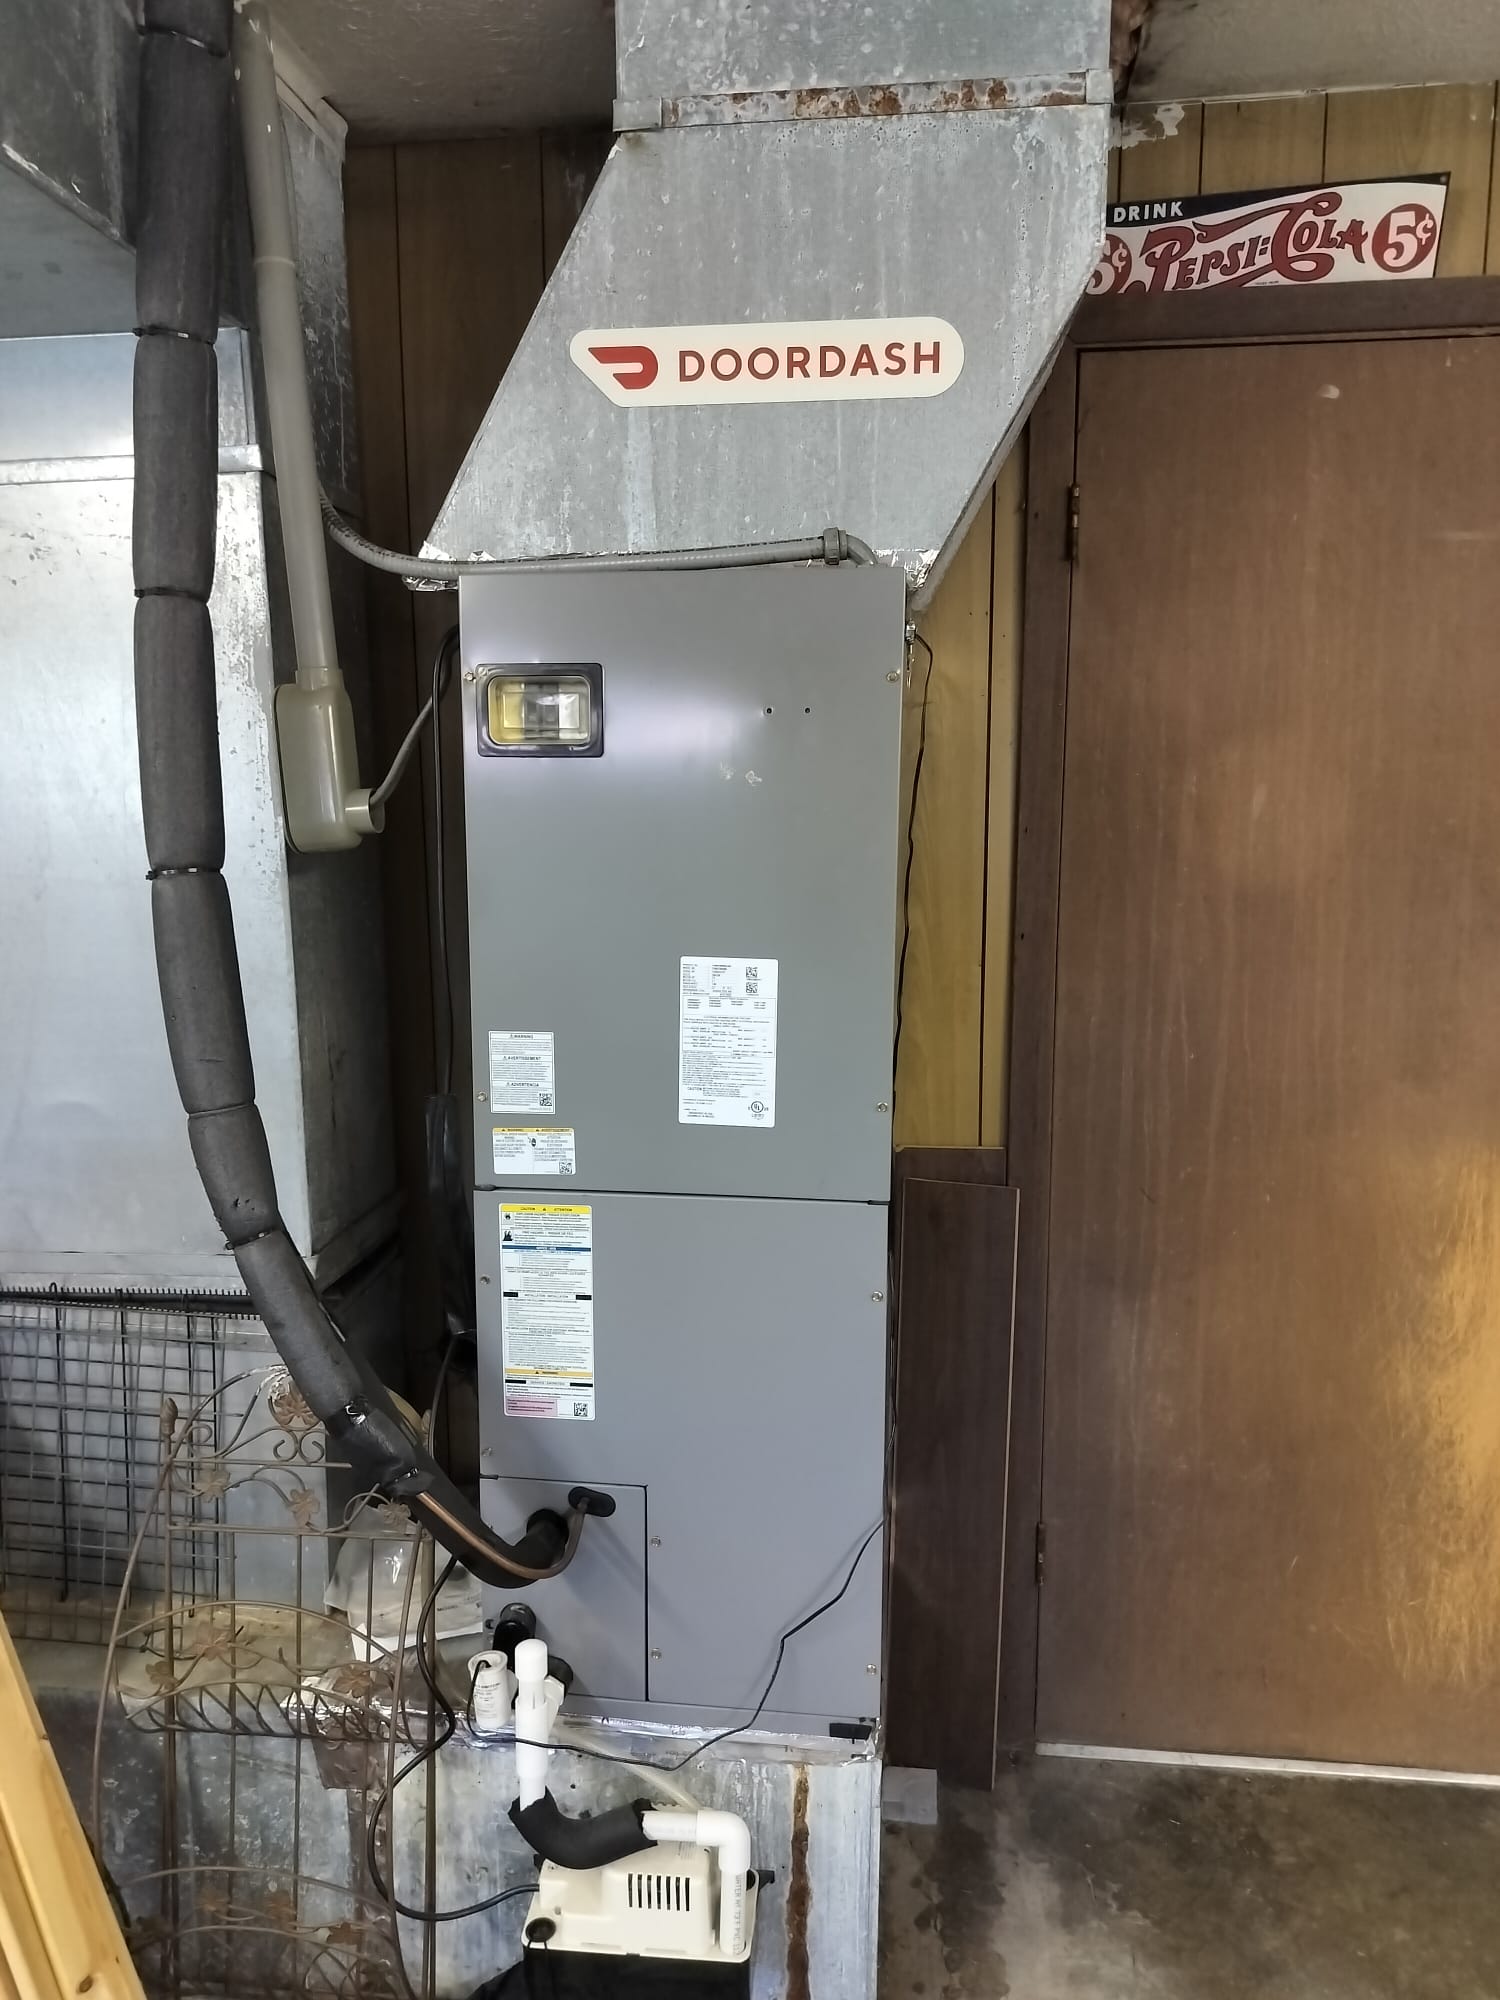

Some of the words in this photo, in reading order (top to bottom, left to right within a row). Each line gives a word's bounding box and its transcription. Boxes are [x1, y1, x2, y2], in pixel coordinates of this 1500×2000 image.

[1113, 201, 1184, 223] DRINK
[1382, 210, 1436, 268] 5¢
[678, 341, 941, 382] DOORDASH
